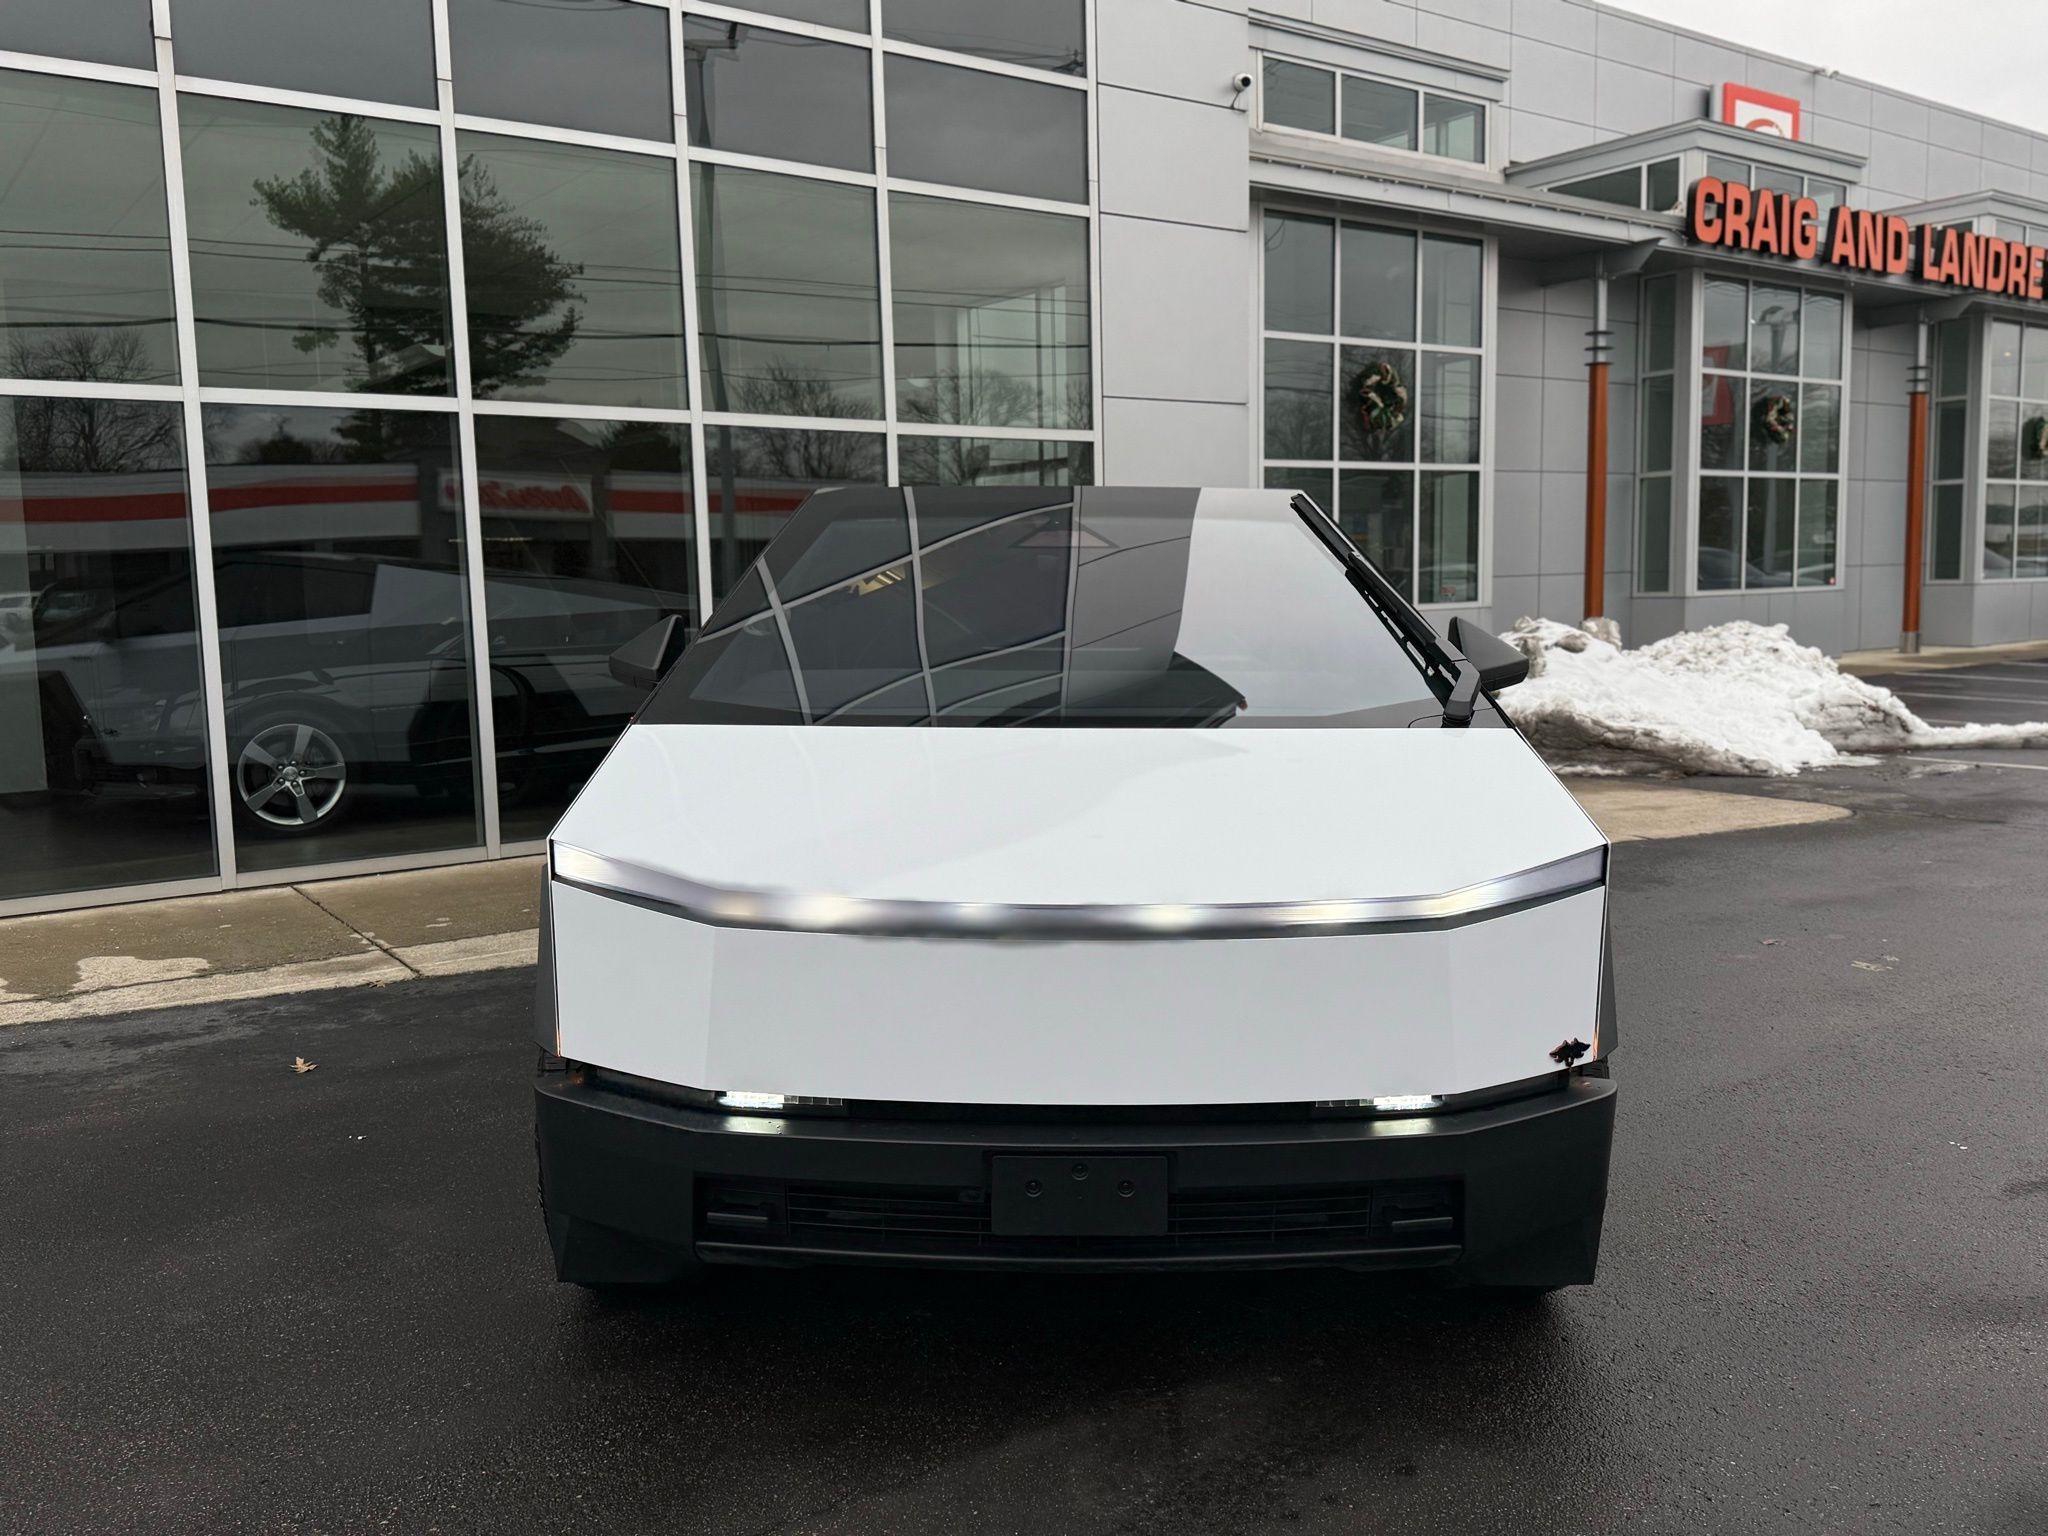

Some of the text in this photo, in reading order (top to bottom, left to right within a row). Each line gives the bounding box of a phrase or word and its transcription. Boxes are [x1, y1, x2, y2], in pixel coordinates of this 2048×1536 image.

[1693, 175, 2046, 300] CRAIG AND LANDRE
